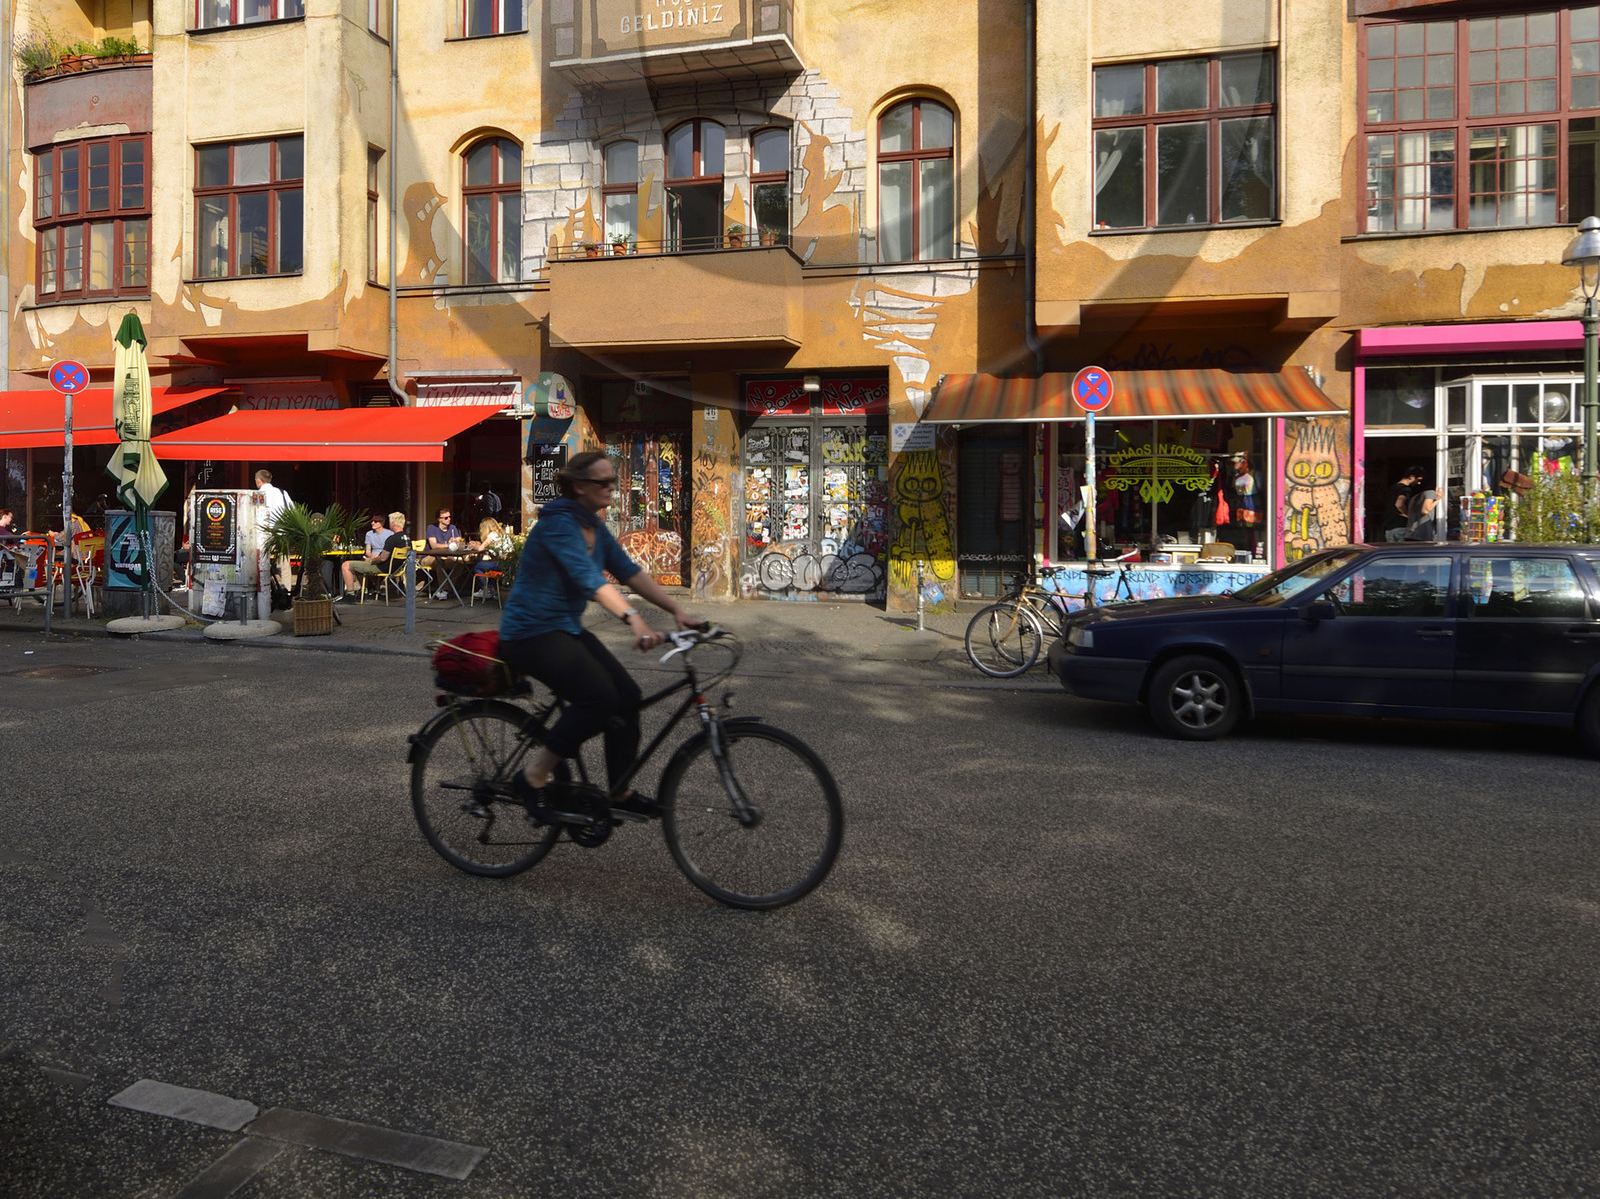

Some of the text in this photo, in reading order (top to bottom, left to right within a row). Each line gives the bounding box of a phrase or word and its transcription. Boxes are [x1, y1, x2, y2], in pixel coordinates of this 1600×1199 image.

[749, 386, 776, 407] No
[822, 381, 852, 403] No
[246, 393, 336, 410] san remo
[763, 385, 805, 415] Borde
[706, 408, 716, 417] 46
[1155, 443, 1168, 455] IN
[535, 459, 554, 468] san
[535, 468, 560, 481] rEM
[1167, 573, 1225, 586] WORSHIP
